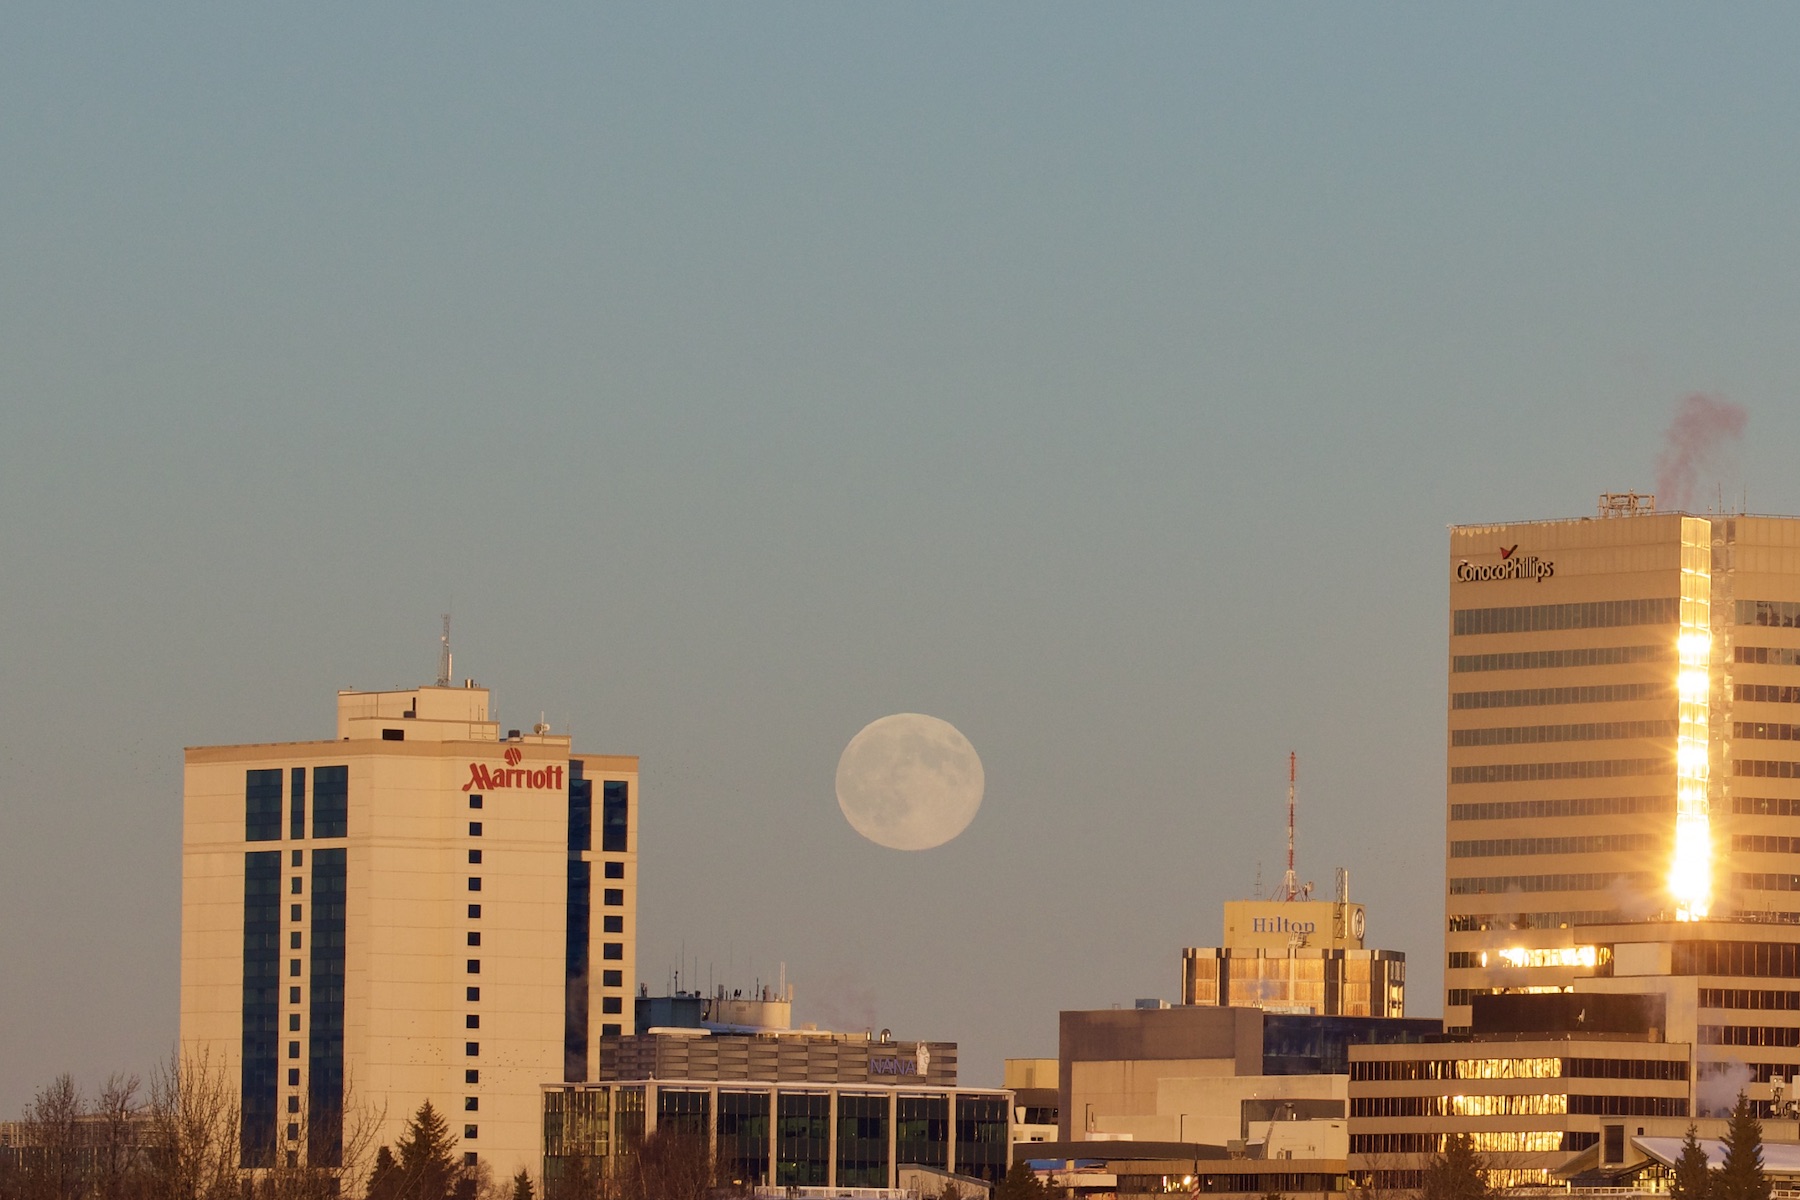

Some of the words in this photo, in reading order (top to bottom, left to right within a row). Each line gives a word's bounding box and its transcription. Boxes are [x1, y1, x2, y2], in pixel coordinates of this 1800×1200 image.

[1457, 556, 1554, 583] ConocoPhillips
[462, 762, 564, 792] Marriott
[1253, 916, 1316, 934] Hilton
[870, 1057, 916, 1076] NANA
